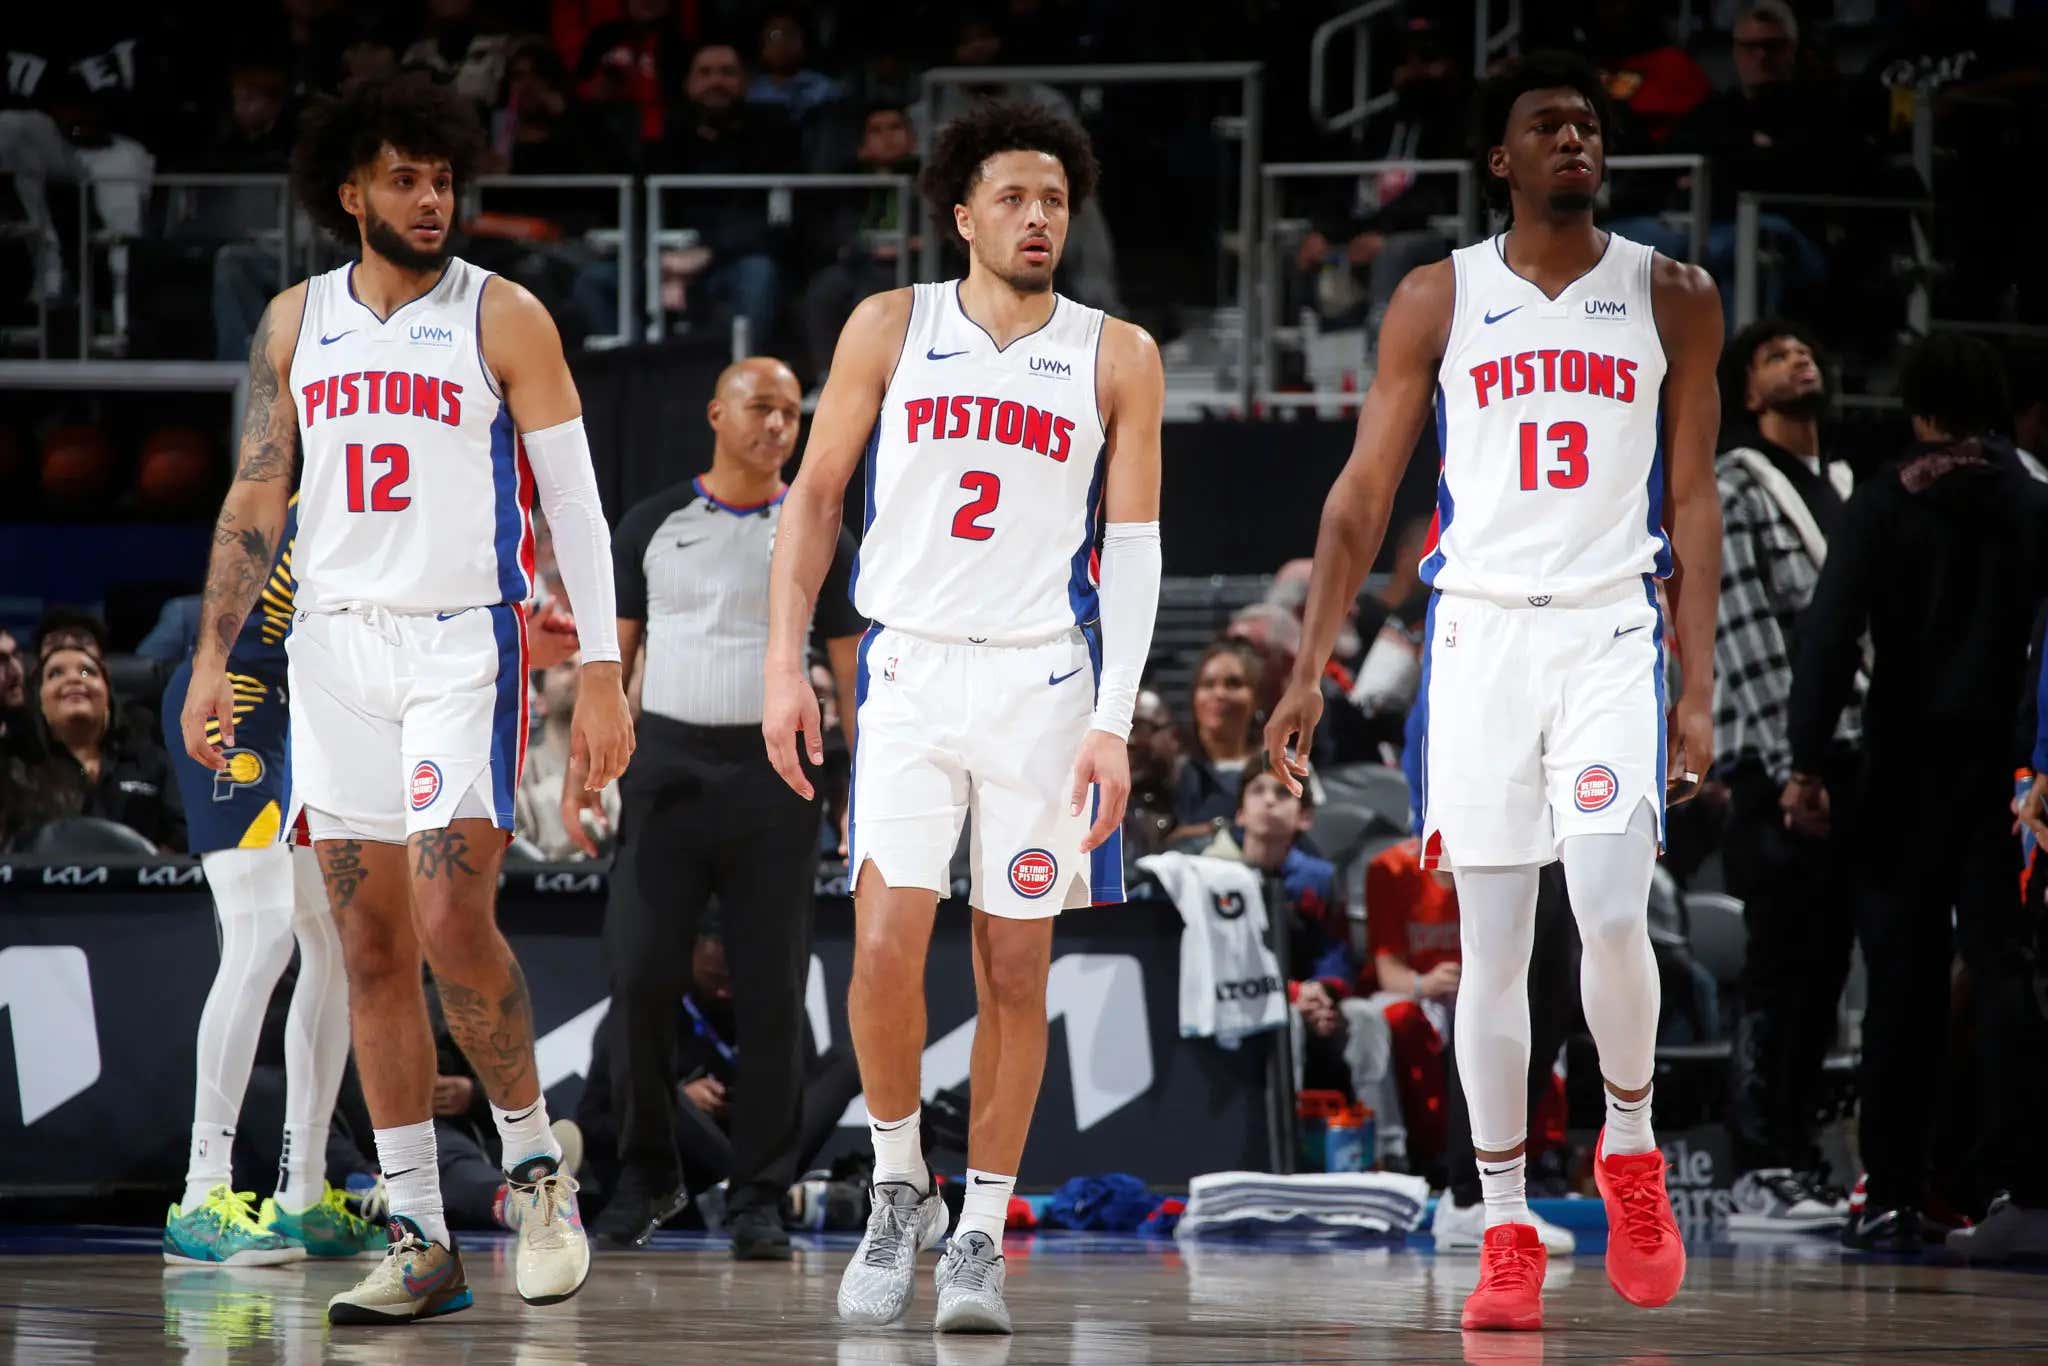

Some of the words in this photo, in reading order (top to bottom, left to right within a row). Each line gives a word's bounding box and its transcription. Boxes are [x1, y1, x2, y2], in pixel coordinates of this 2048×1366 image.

[1585, 300, 1626, 316] UWM
[410, 325, 452, 342] UWM
[1029, 356, 1071, 376] UWM
[1469, 349, 1638, 409] PISTONS
[302, 371, 463, 428] PISTONS
[904, 395, 1075, 463] PISTONS
[1519, 421, 1589, 491] 13
[345, 443, 411, 513] 12
[951, 470, 1001, 541] 2
[43, 865, 107, 884] KIA
[535, 872, 600, 893] KIA
[1018, 873, 1049, 882] PISTONS
[1020, 865, 1049, 873] DETROIT
[1671, 1189, 1731, 1222] ars
